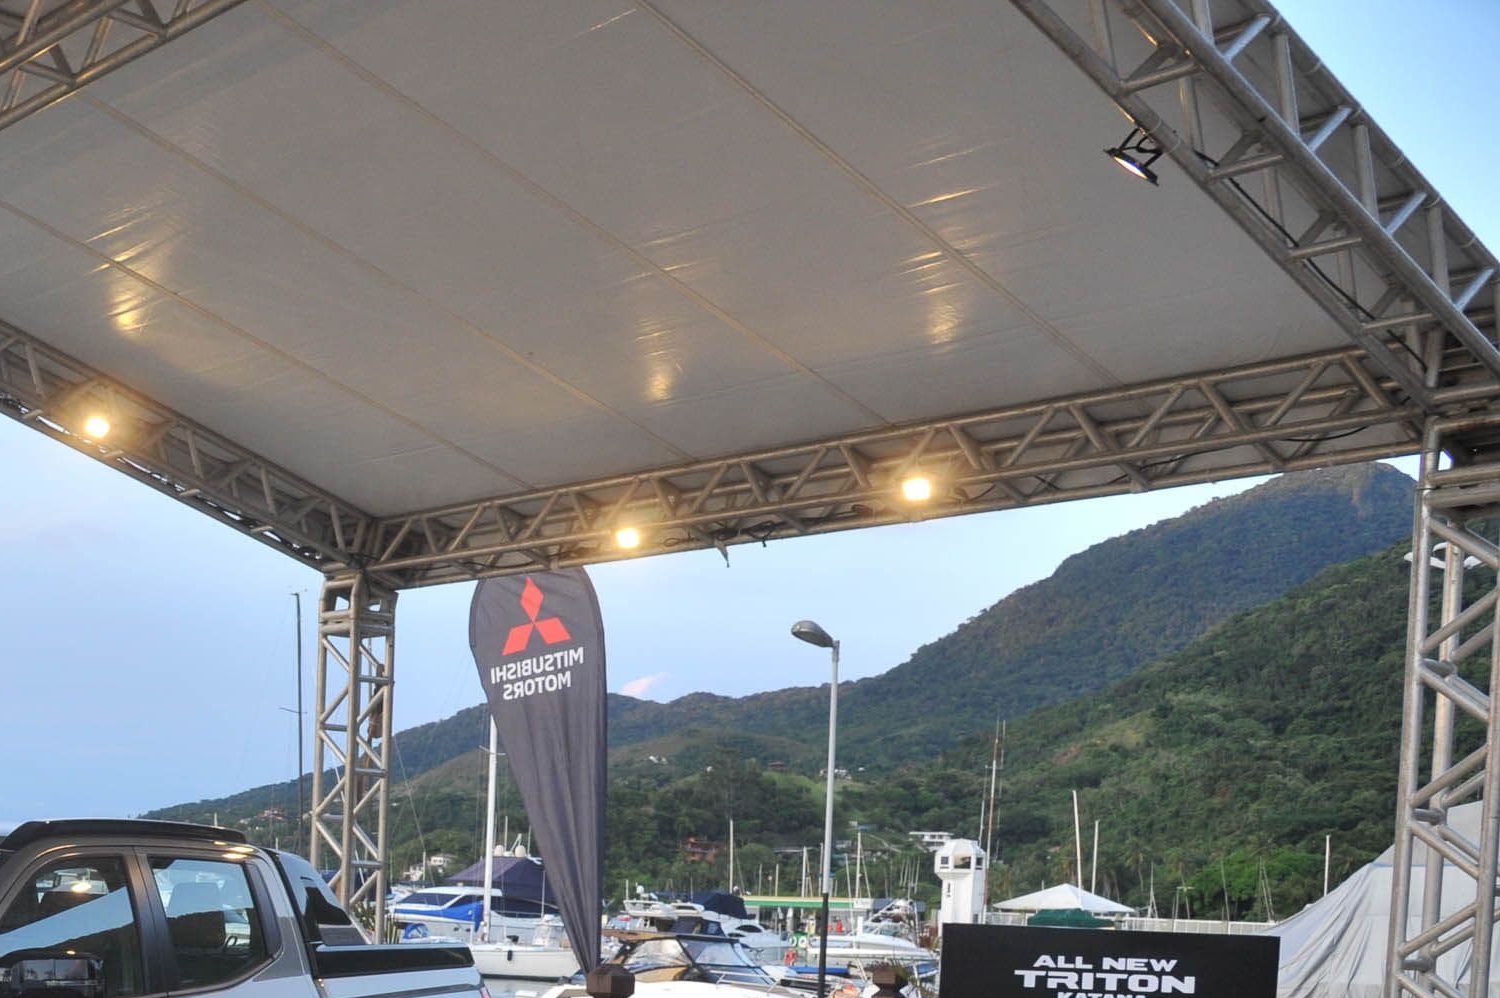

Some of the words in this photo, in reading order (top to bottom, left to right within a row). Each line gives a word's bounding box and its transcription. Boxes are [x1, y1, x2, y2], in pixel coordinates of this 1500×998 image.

[1032, 954, 1093, 969] ALL
[1102, 956, 1178, 972] NEW
[1014, 969, 1196, 994] TRITON
